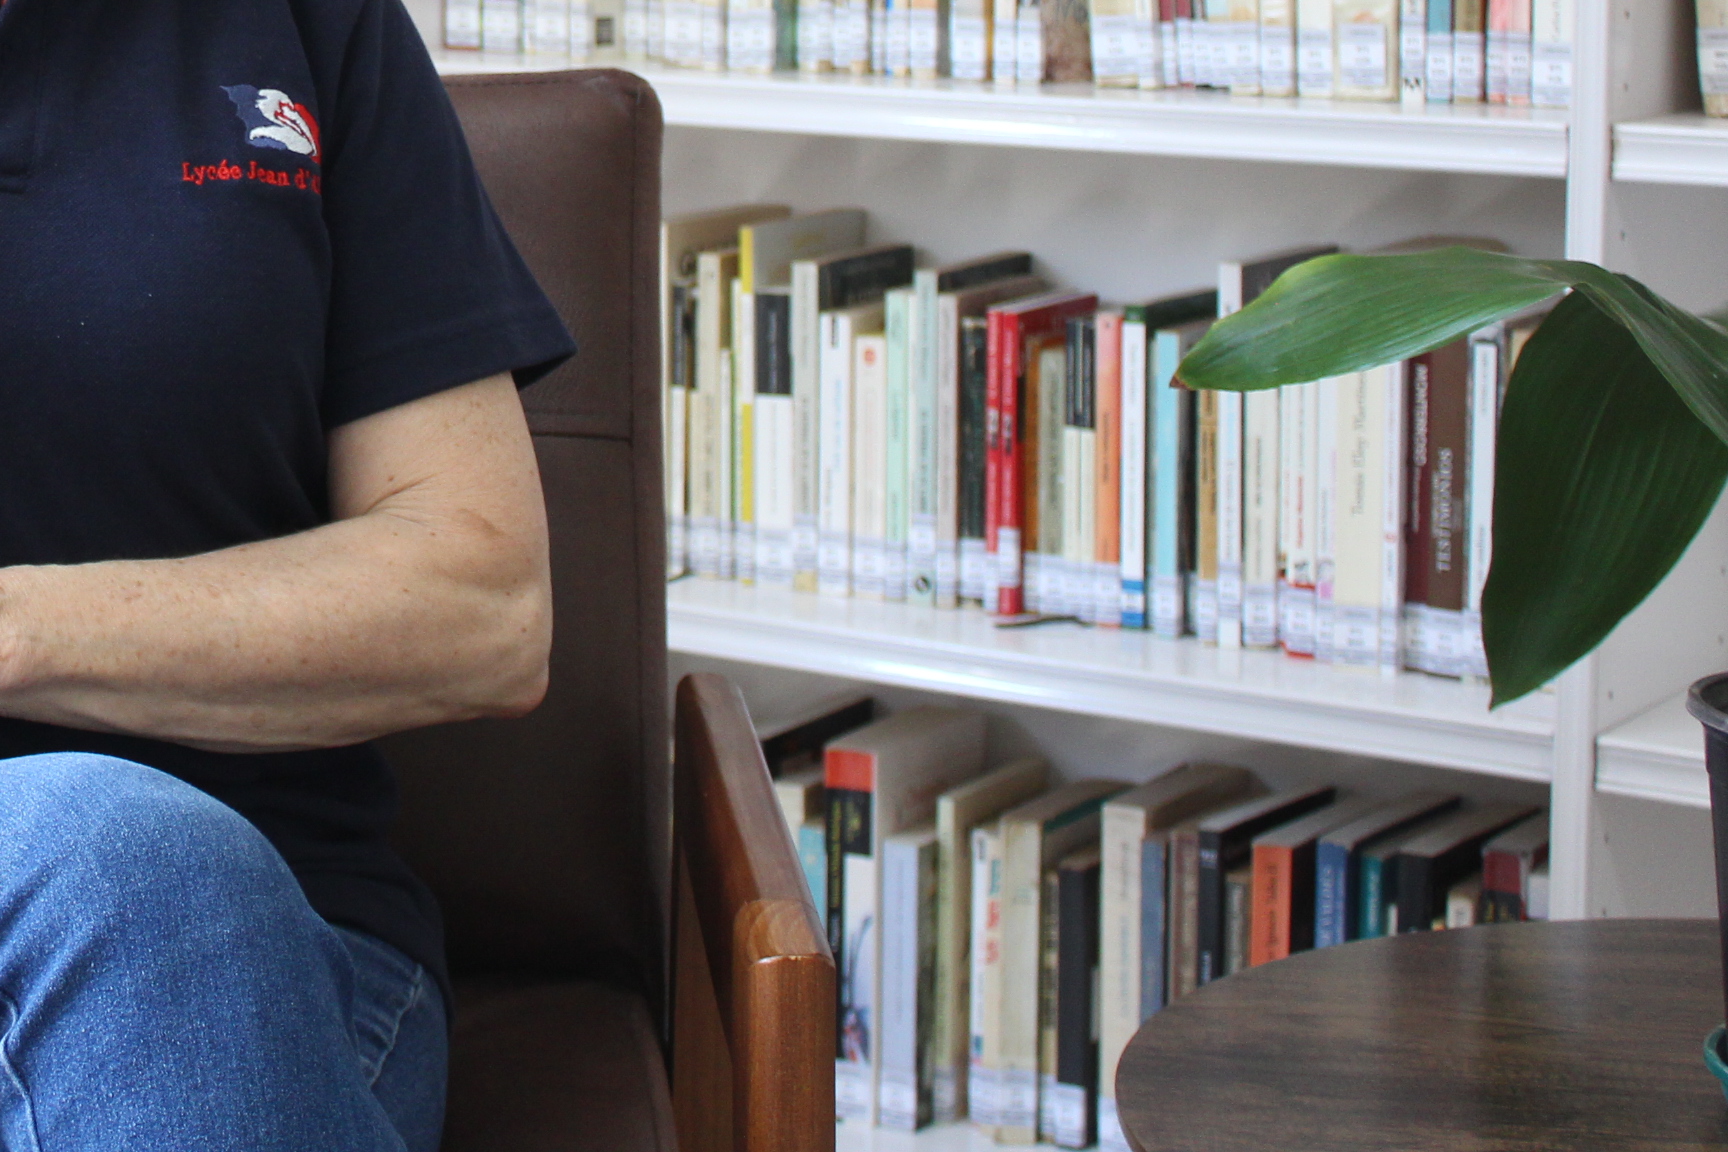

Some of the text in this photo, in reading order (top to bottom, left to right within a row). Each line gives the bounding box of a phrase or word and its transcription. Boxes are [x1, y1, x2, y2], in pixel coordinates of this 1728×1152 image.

[181, 159, 242, 185] Lycée
[247, 160, 290, 186] Jean
[1435, 447, 1455, 574] TESTIMONIOS
